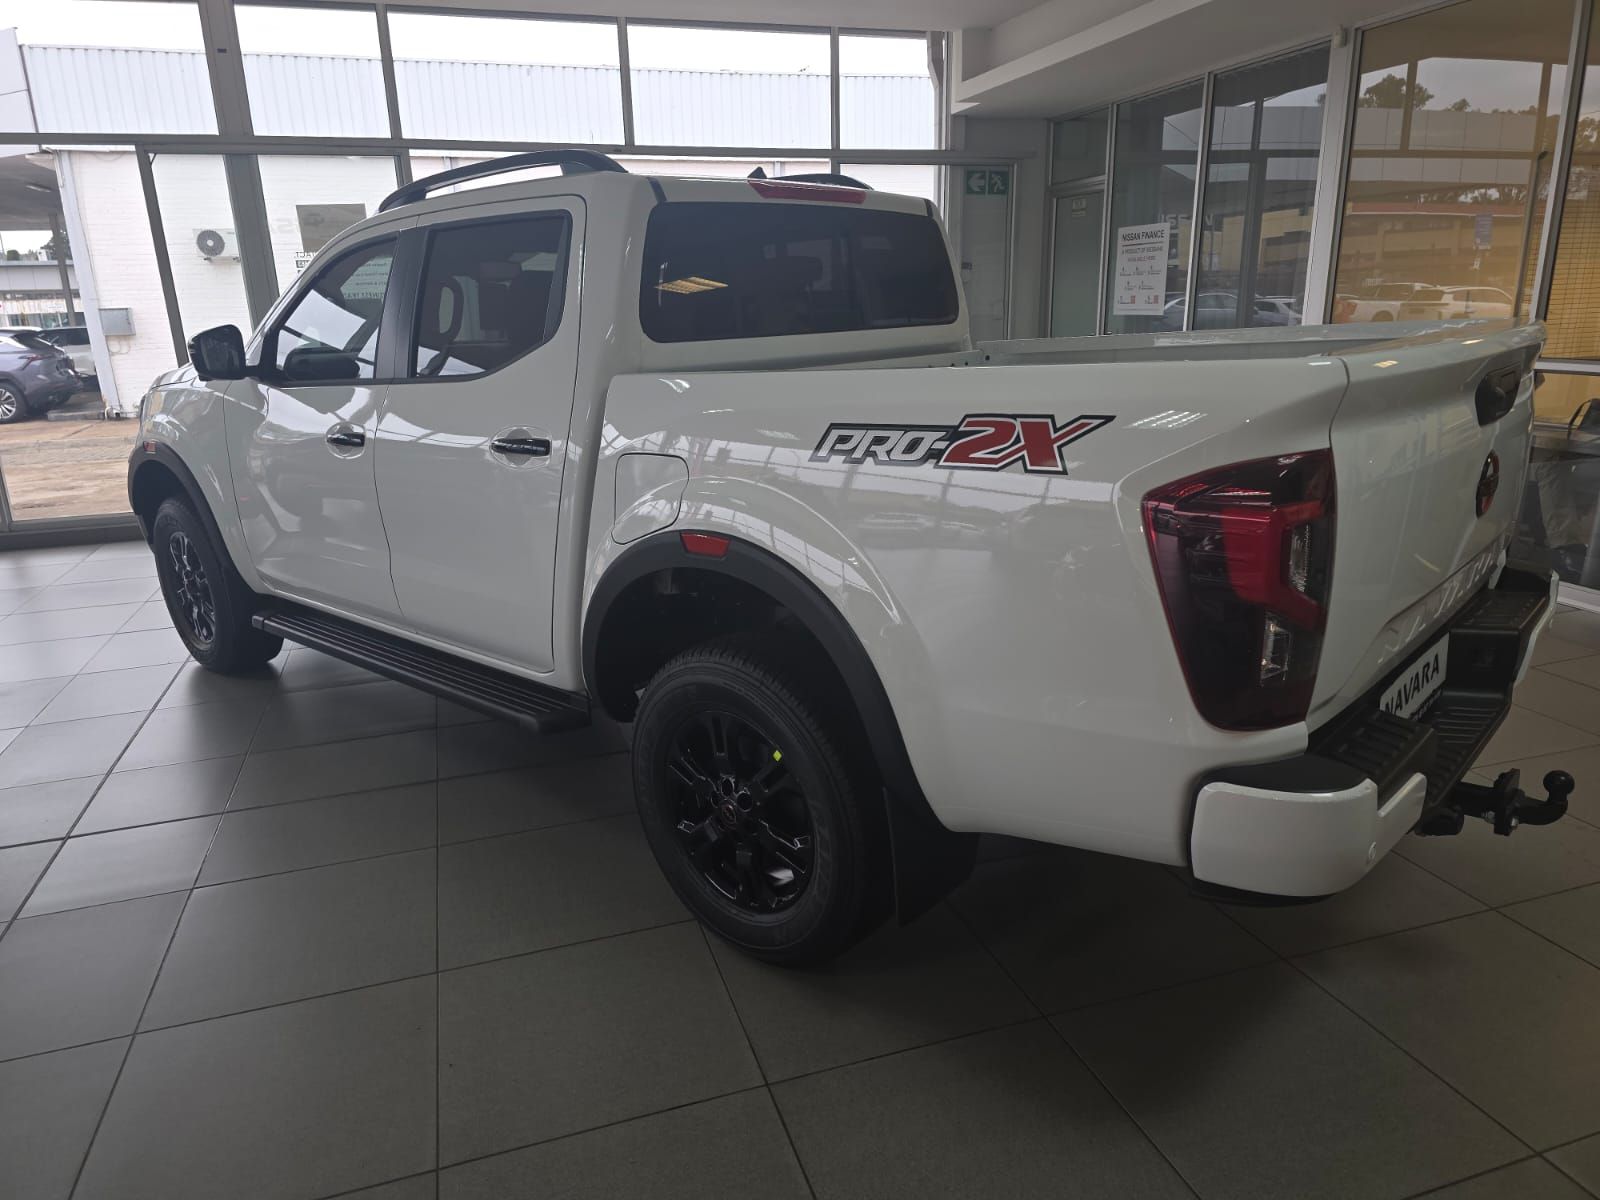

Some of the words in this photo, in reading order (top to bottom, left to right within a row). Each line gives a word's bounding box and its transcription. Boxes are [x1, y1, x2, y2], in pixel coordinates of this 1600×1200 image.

[1122, 232, 1140, 241] NISSAN
[1141, 229, 1165, 240] FINANCE
[808, 413, 1117, 476] PRO-2X
[1384, 652, 1440, 717] NAVARA
